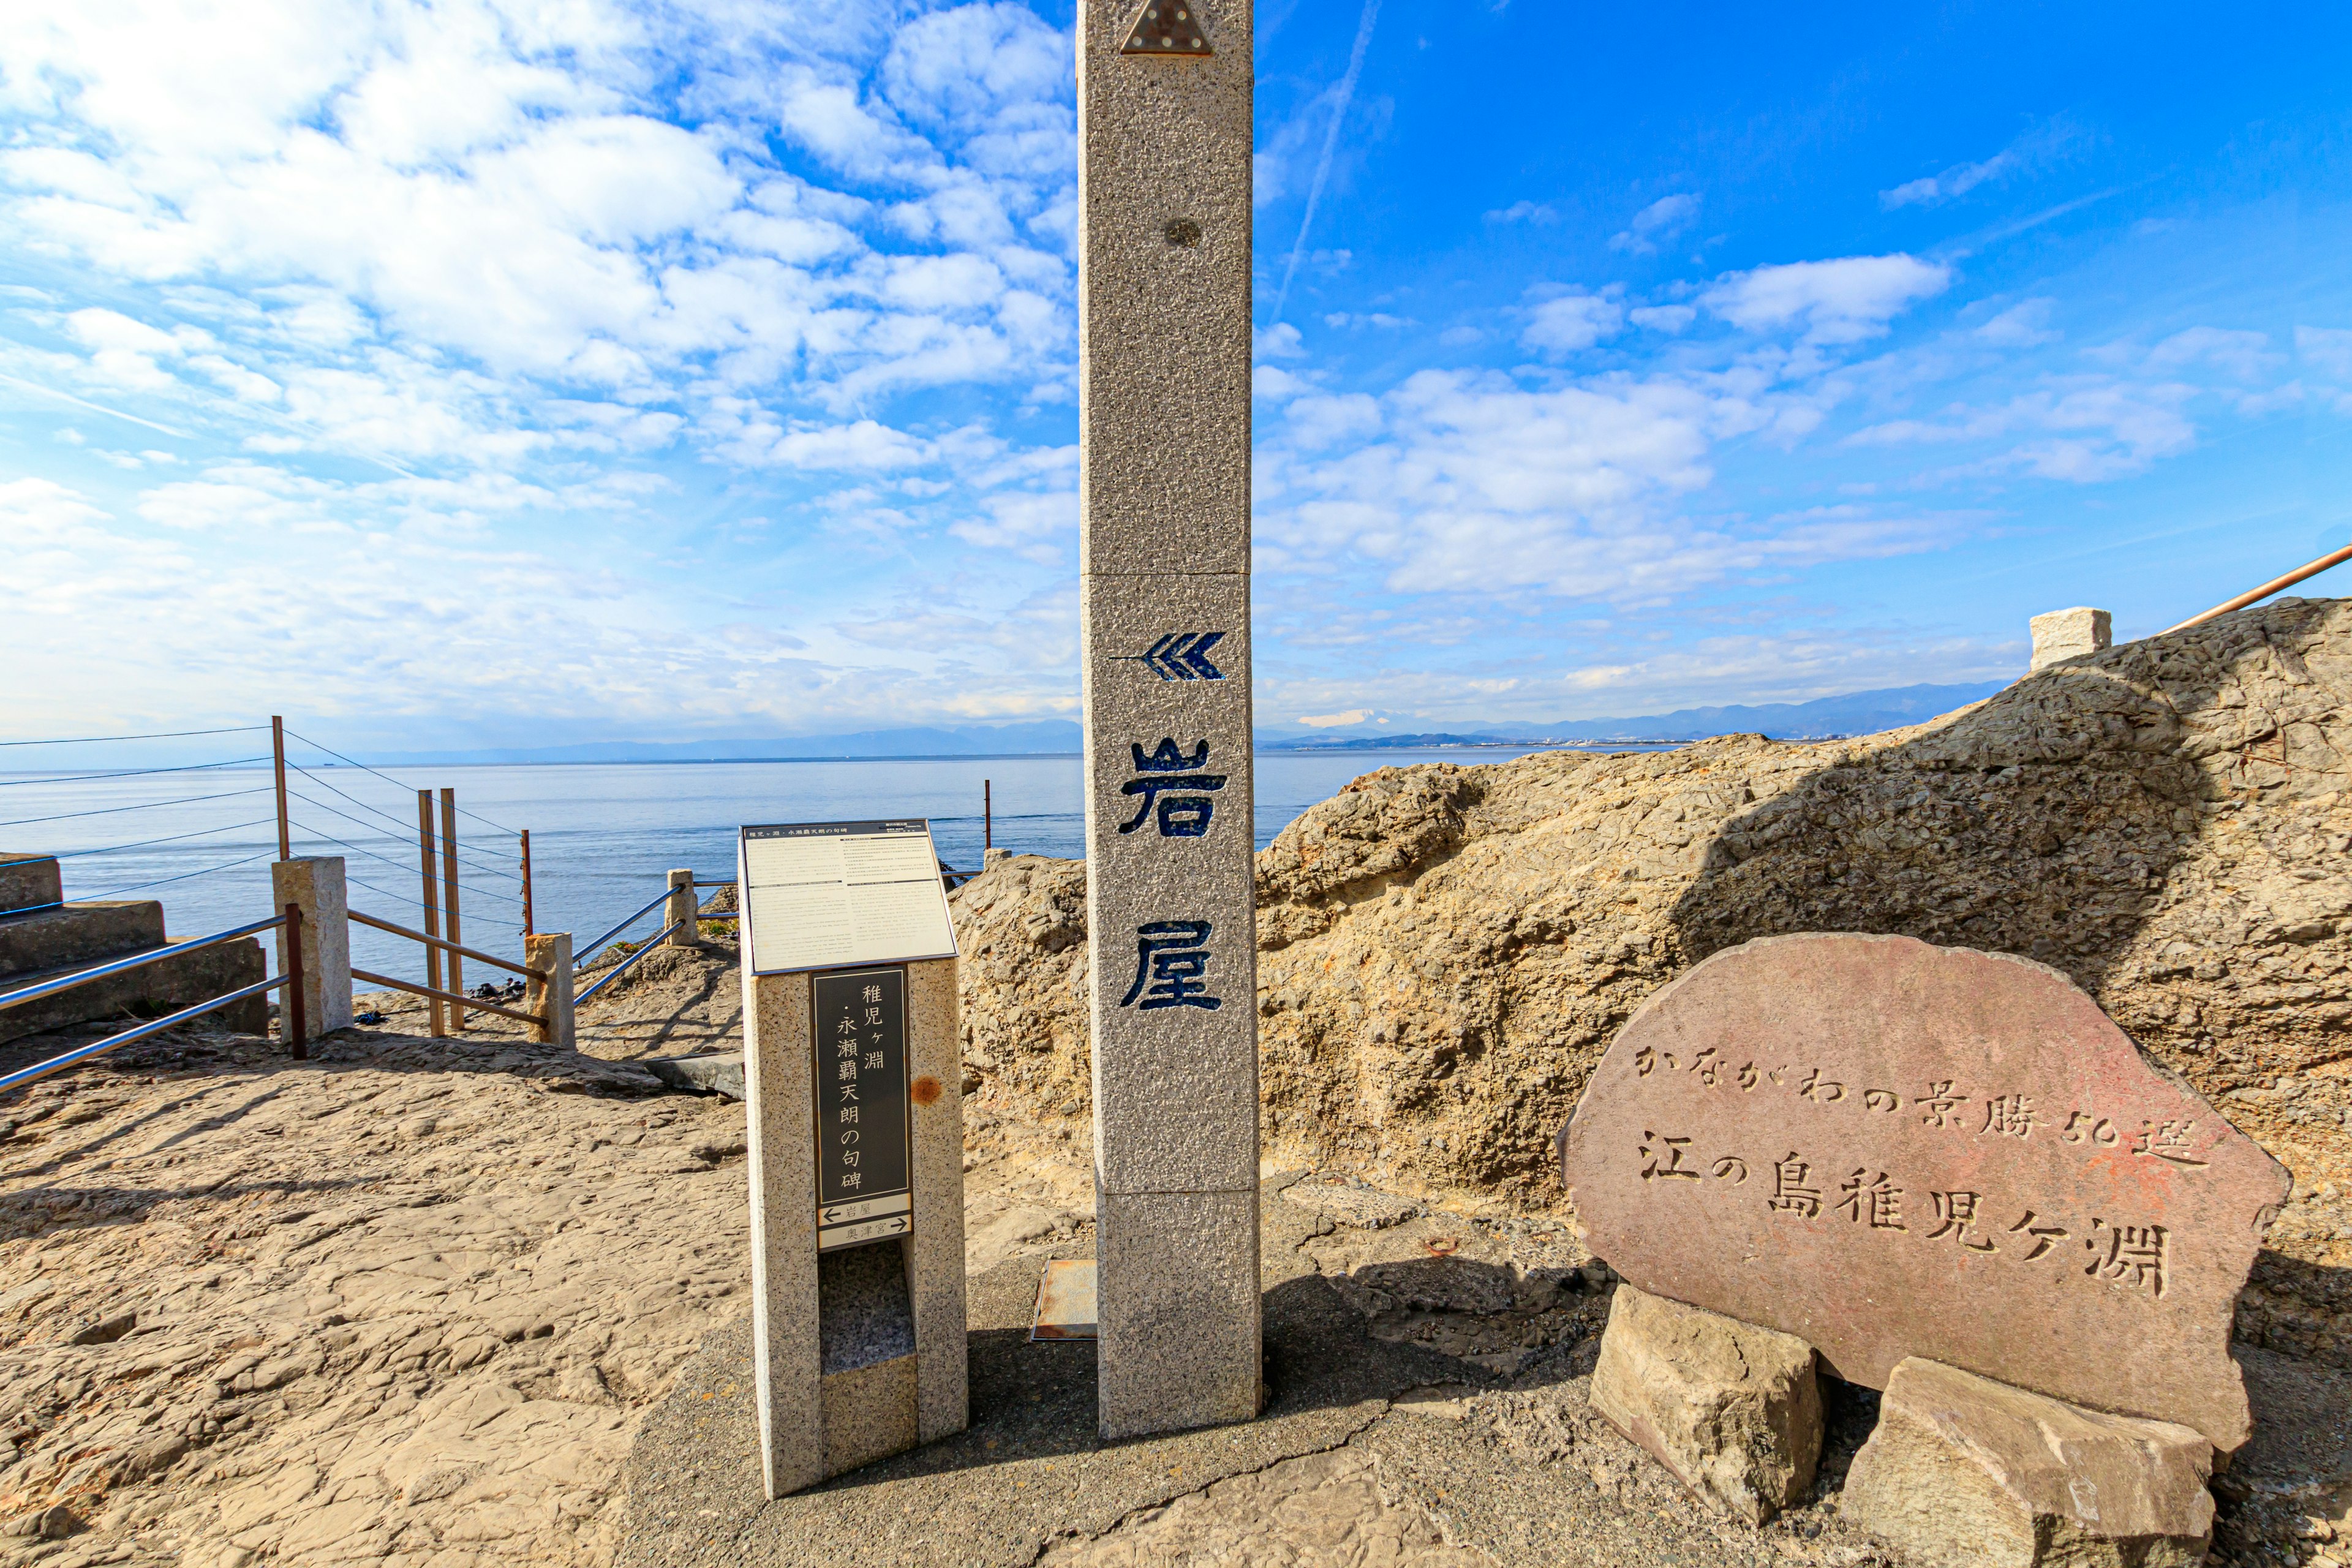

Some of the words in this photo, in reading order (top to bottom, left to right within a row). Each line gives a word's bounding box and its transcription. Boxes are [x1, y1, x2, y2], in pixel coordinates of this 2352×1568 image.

[1118, 737, 1227, 1011] 岩屋
[1634, 1044, 2211, 1171] かながわの景勝50選
[845, 1203, 872, 1218] 岩屋
[845, 1223, 887, 1240] 奥津宮
